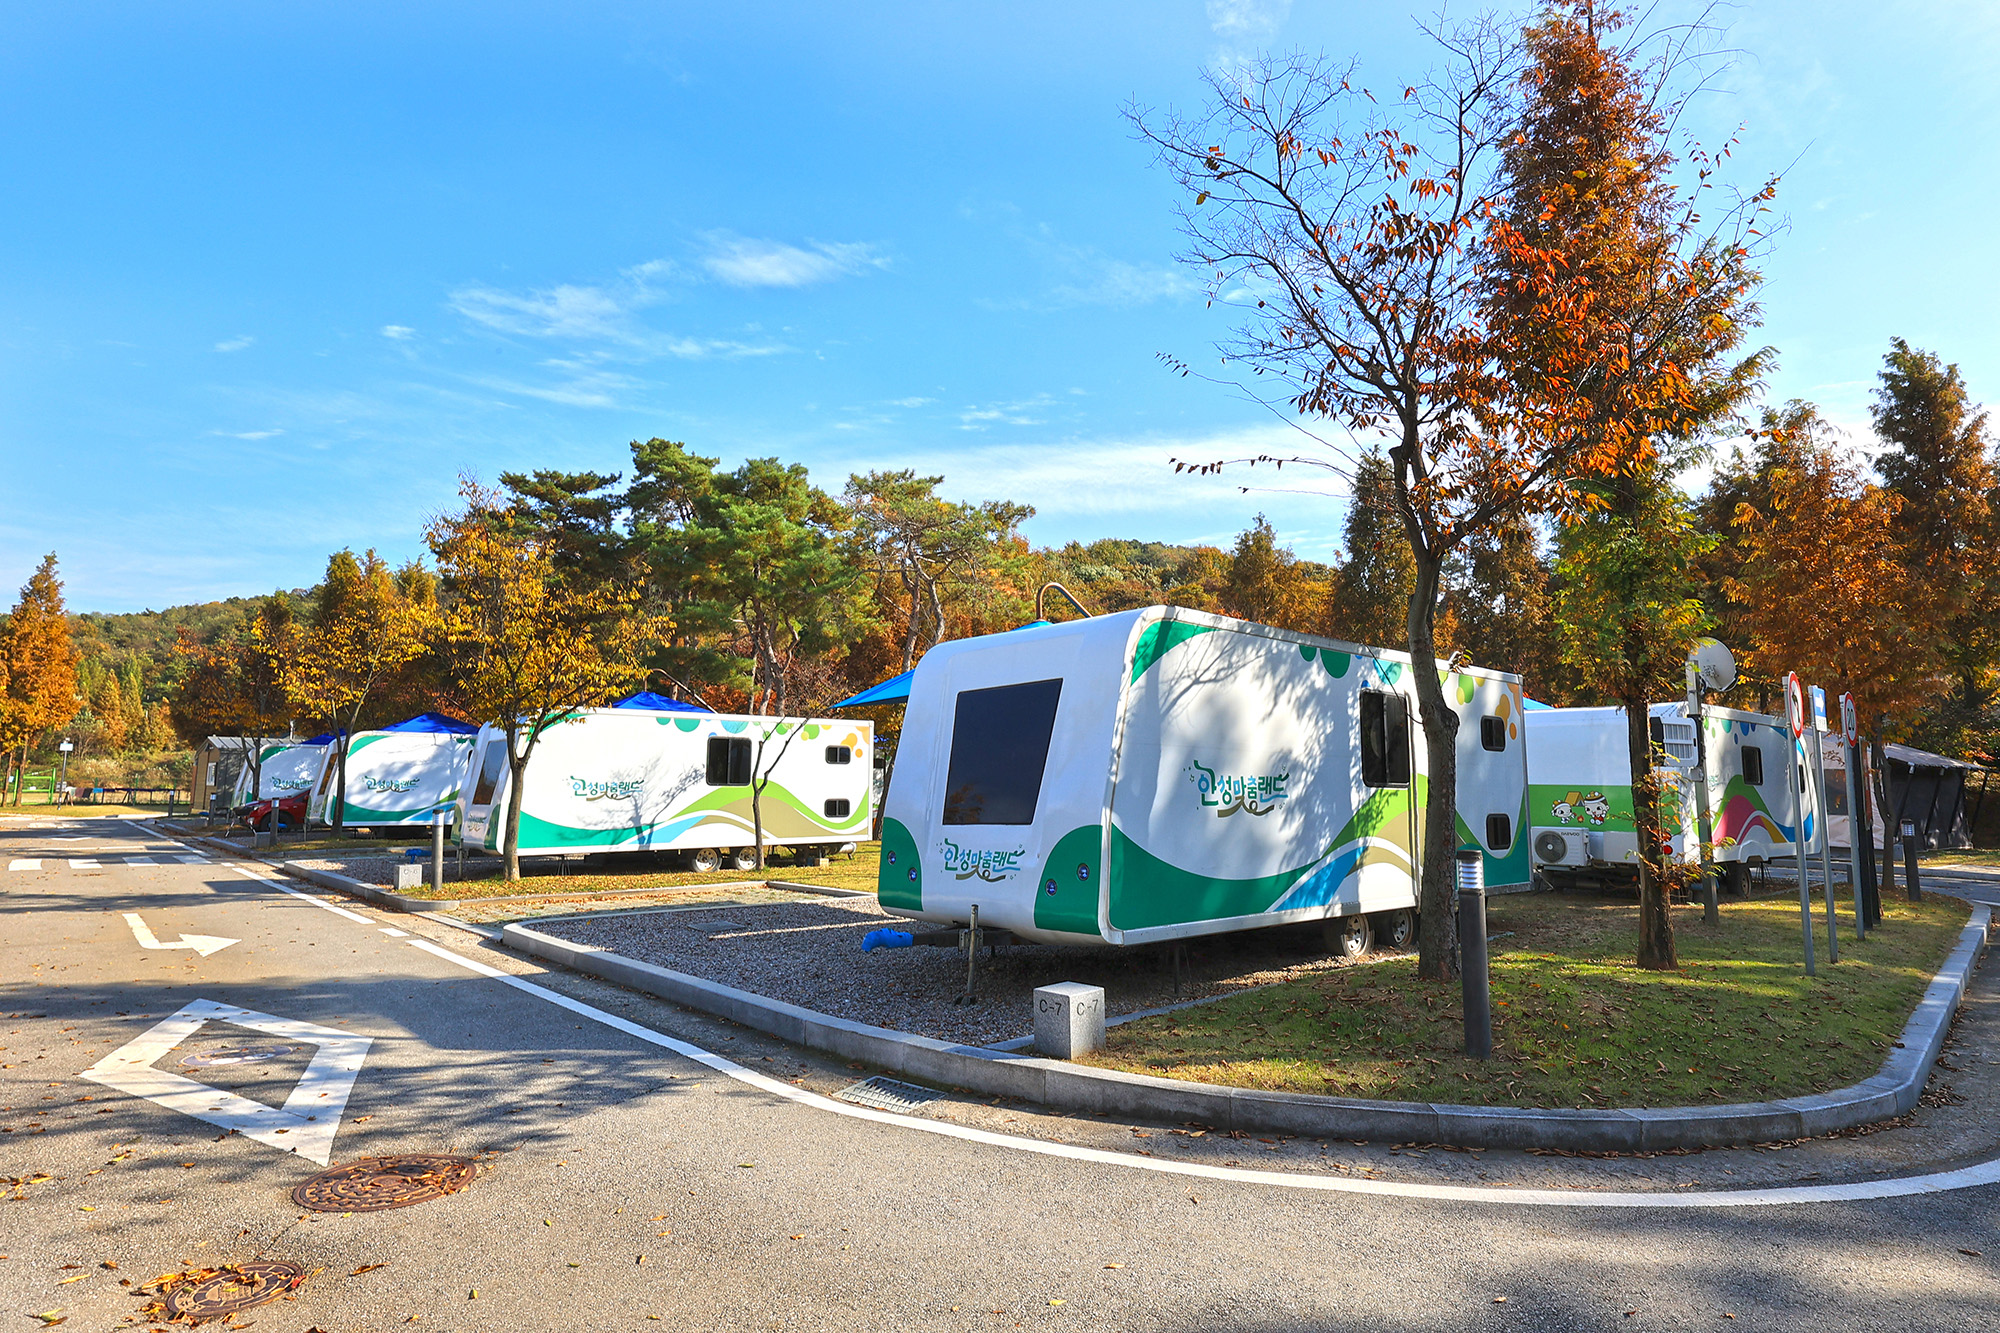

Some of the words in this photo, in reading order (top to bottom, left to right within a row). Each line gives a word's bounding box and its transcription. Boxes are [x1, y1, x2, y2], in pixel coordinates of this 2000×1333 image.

[1847, 707, 1855, 731] 20
[570, 776, 644, 801] 안성맞춤랜드
[1194, 760, 1290, 818] 안성맞춤랜드
[944, 838, 1026, 883] 안성맞춤랜드
[1040, 999, 1062, 1016] C-7
[1076, 999, 1099, 1016] C-7
